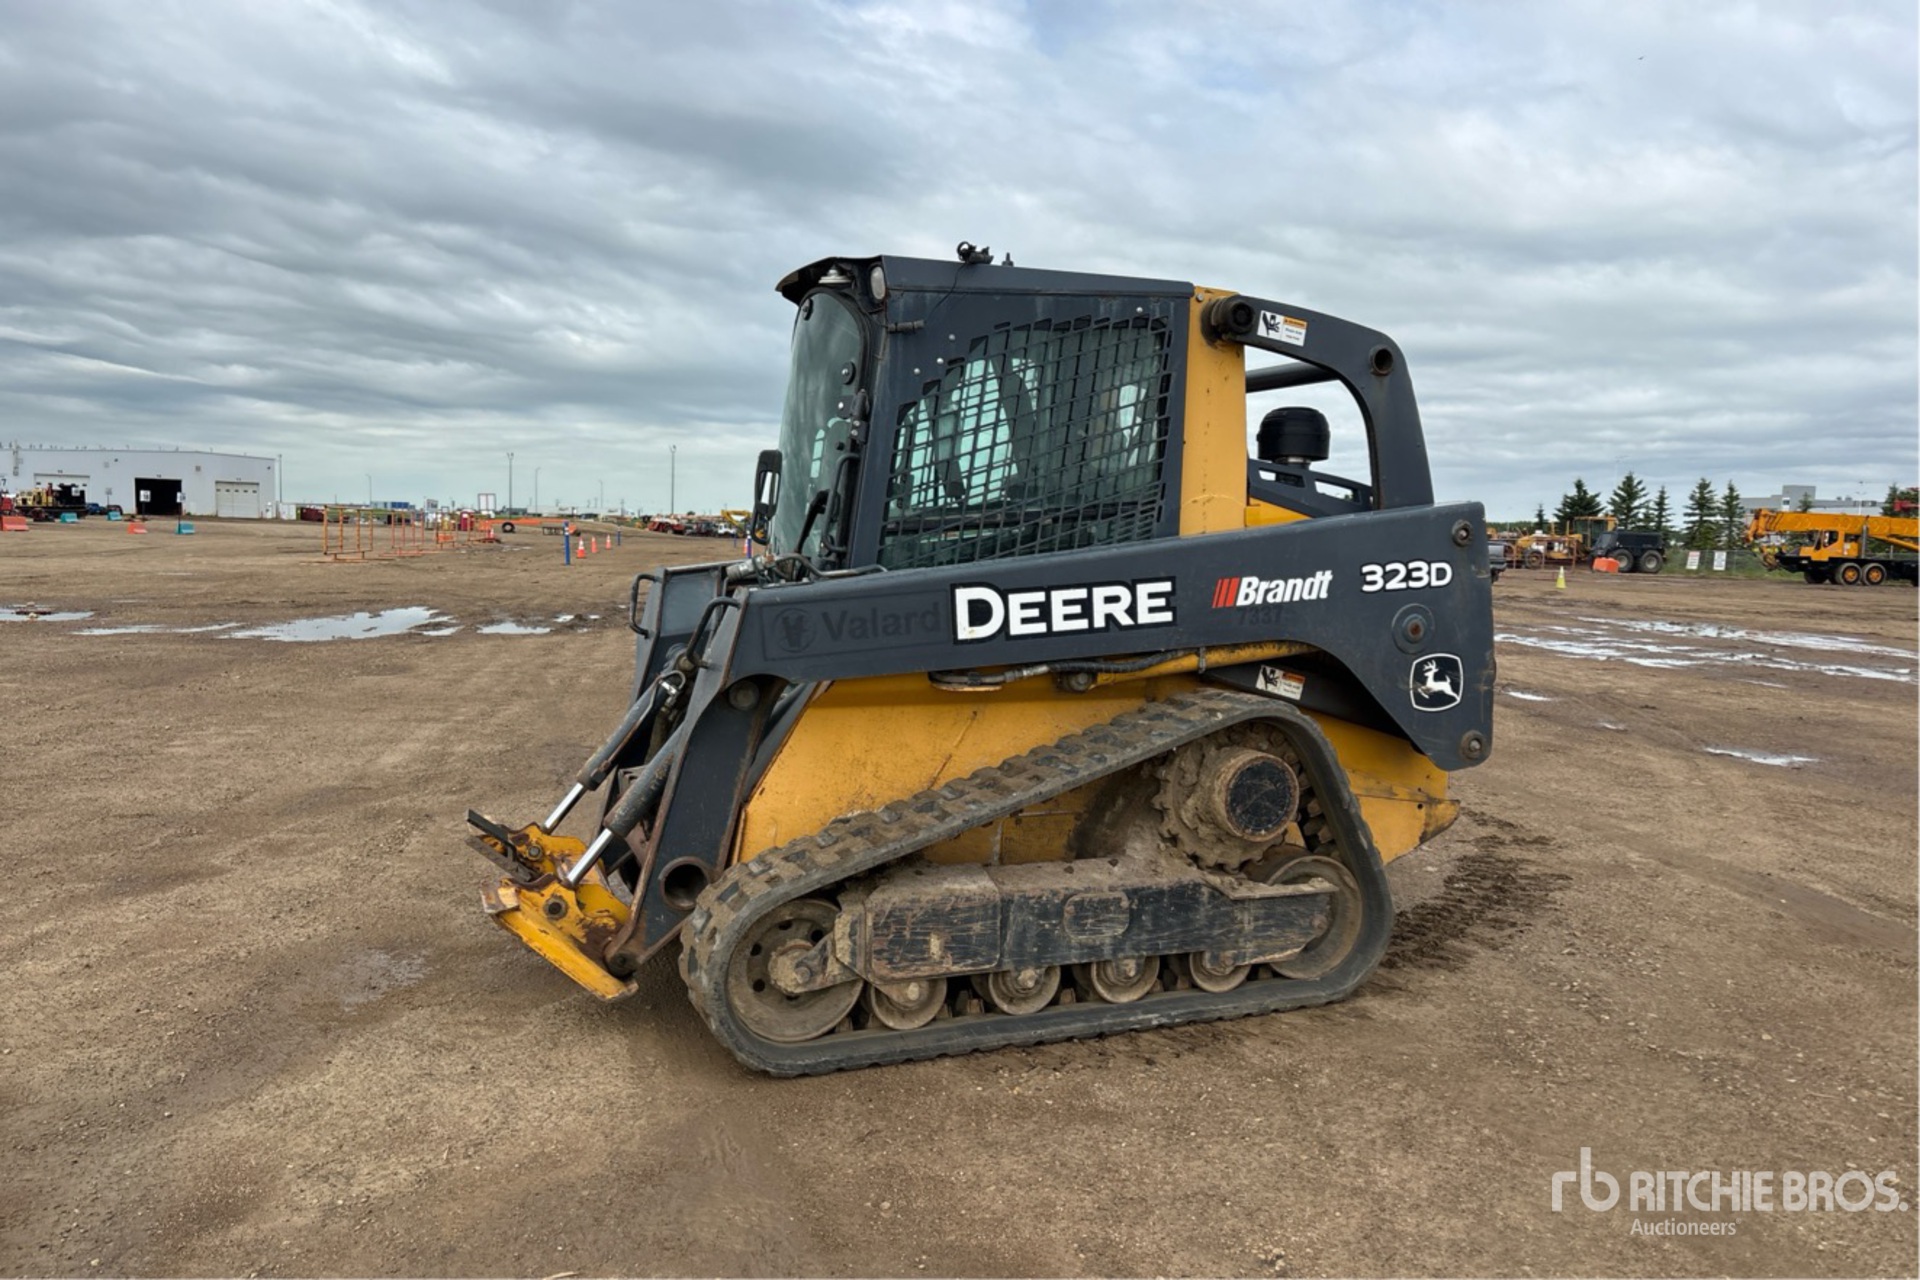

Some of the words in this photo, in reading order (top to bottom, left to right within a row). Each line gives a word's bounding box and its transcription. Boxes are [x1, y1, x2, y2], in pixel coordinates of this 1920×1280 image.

[1236, 569, 1333, 607] Brandt
[1360, 560, 1453, 592] 323D
[821, 601, 941, 641] Valard
[954, 580, 1173, 641] DEERE
